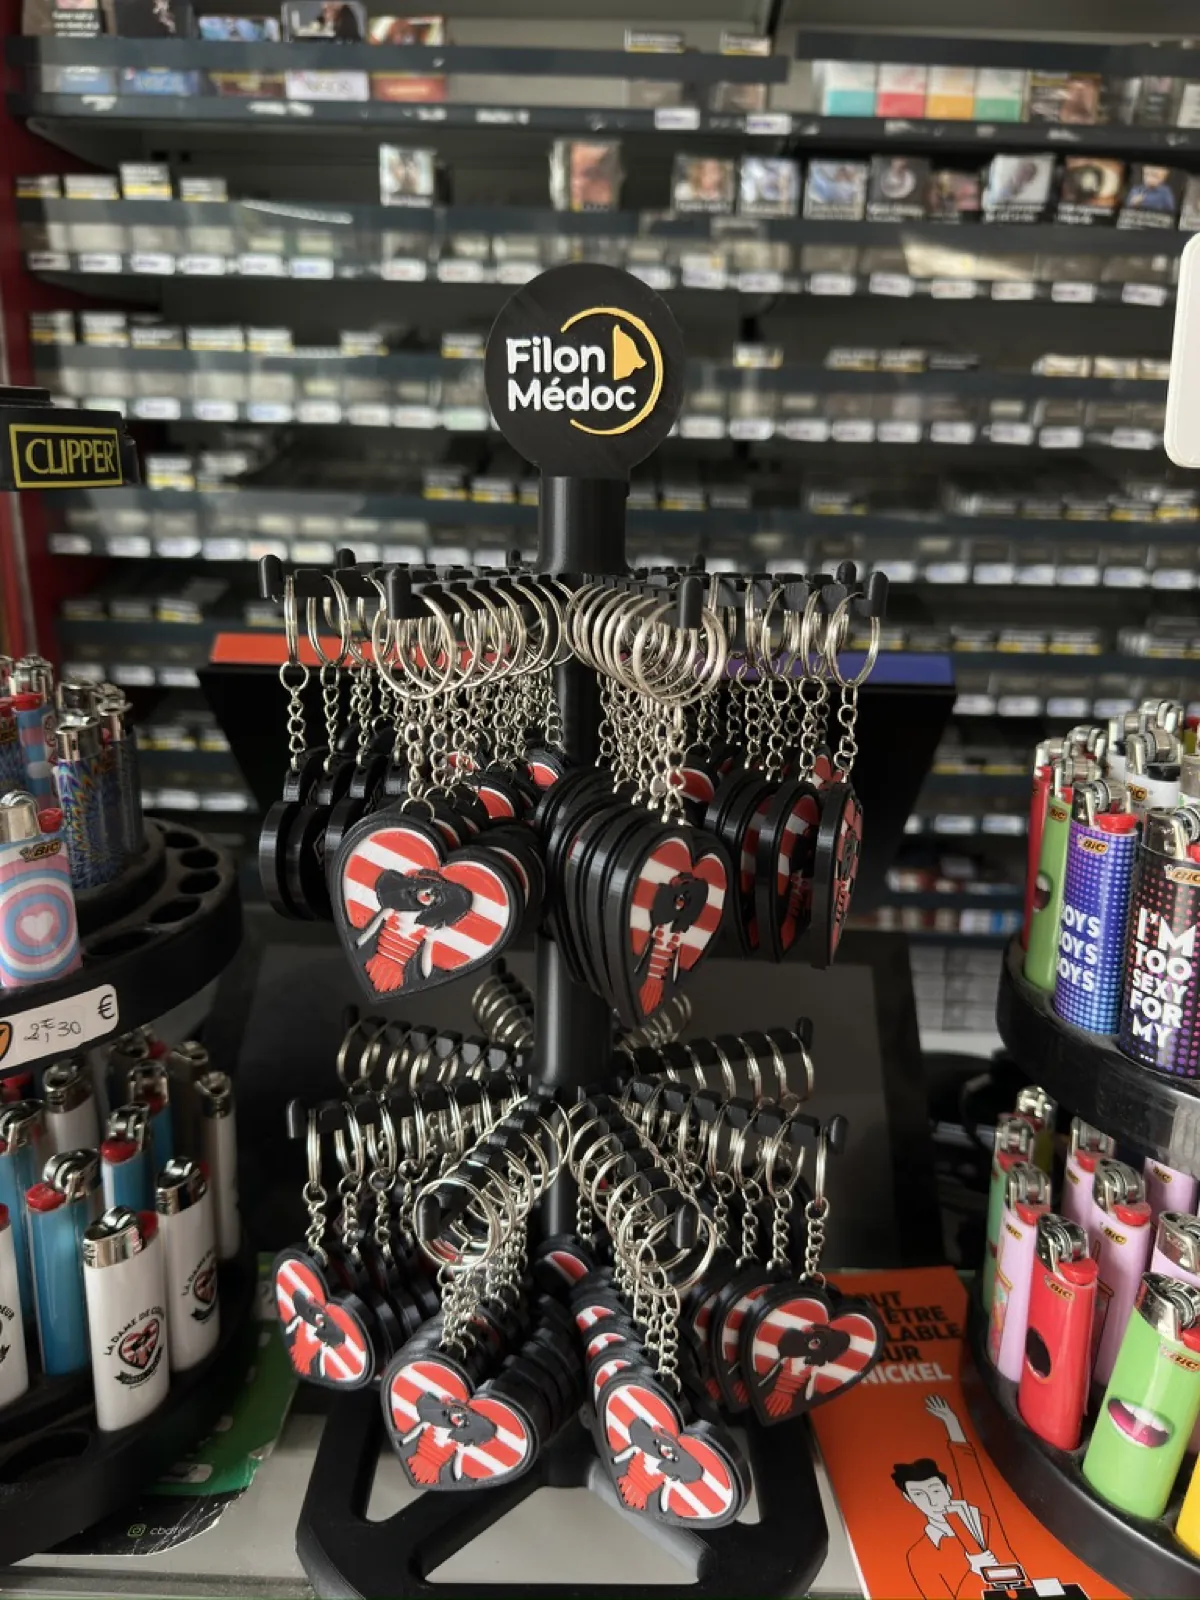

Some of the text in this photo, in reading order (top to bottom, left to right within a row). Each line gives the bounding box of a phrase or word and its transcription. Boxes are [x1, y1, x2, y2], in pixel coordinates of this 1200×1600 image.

[506, 336, 606, 374] Filon
[507, 376, 637, 412] Médoc
[25, 438, 116, 475] CLIPPER
[1061, 904, 1100, 938] OYS
[1137, 907, 1196, 957] I'M
[1058, 931, 1098, 965] OYS
[1135, 940, 1192, 981] TOO
[1056, 957, 1096, 992] OYS
[1132, 968, 1188, 1003] SEXY
[1129, 988, 1184, 1028] FOR
[1132, 1015, 1173, 1048] MY
[878, 1345, 923, 1362] UR
